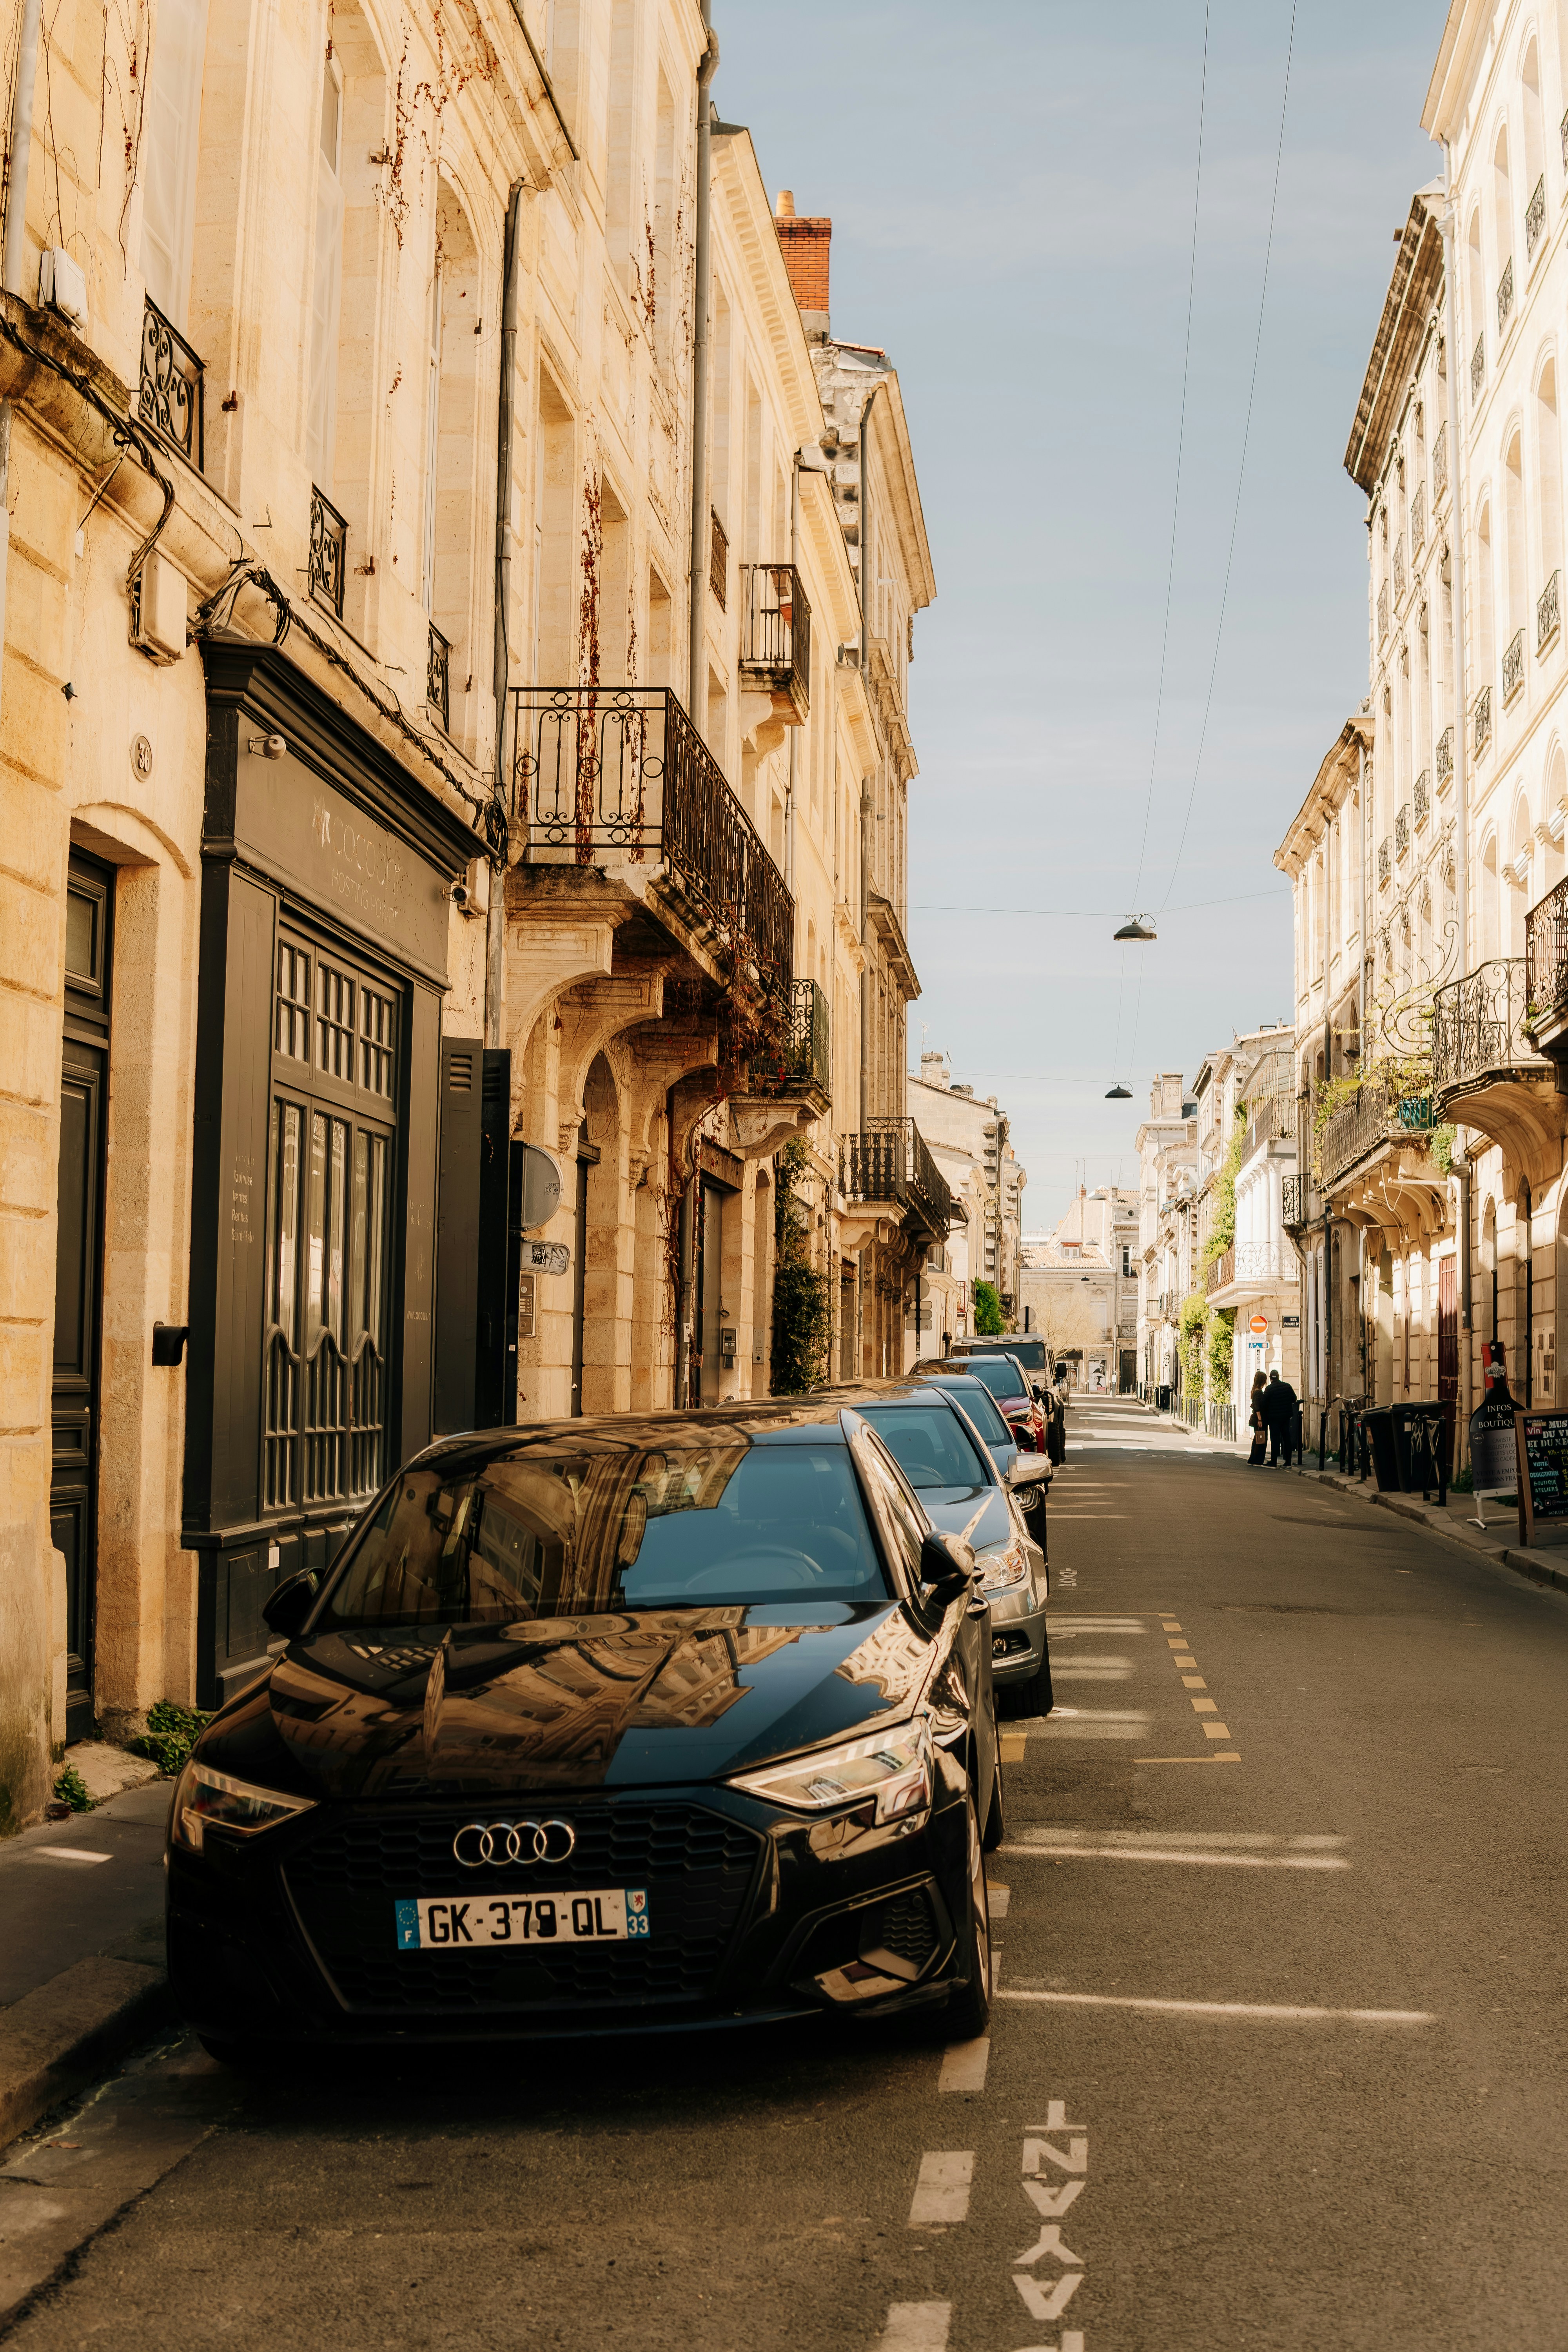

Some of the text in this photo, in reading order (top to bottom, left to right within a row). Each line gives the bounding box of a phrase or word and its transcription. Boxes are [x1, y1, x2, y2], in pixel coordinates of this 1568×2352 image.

[138, 742, 150, 772] 36
[1487, 1404, 1512, 1412] INFOS
[1543, 1430, 1555, 1439] DU
[1540, 1439, 1553, 1447] DU
[428, 1897, 618, 1943] GK-379-QL
[628, 1915, 649, 1935] 33
[405, 1930, 413, 1942] F
